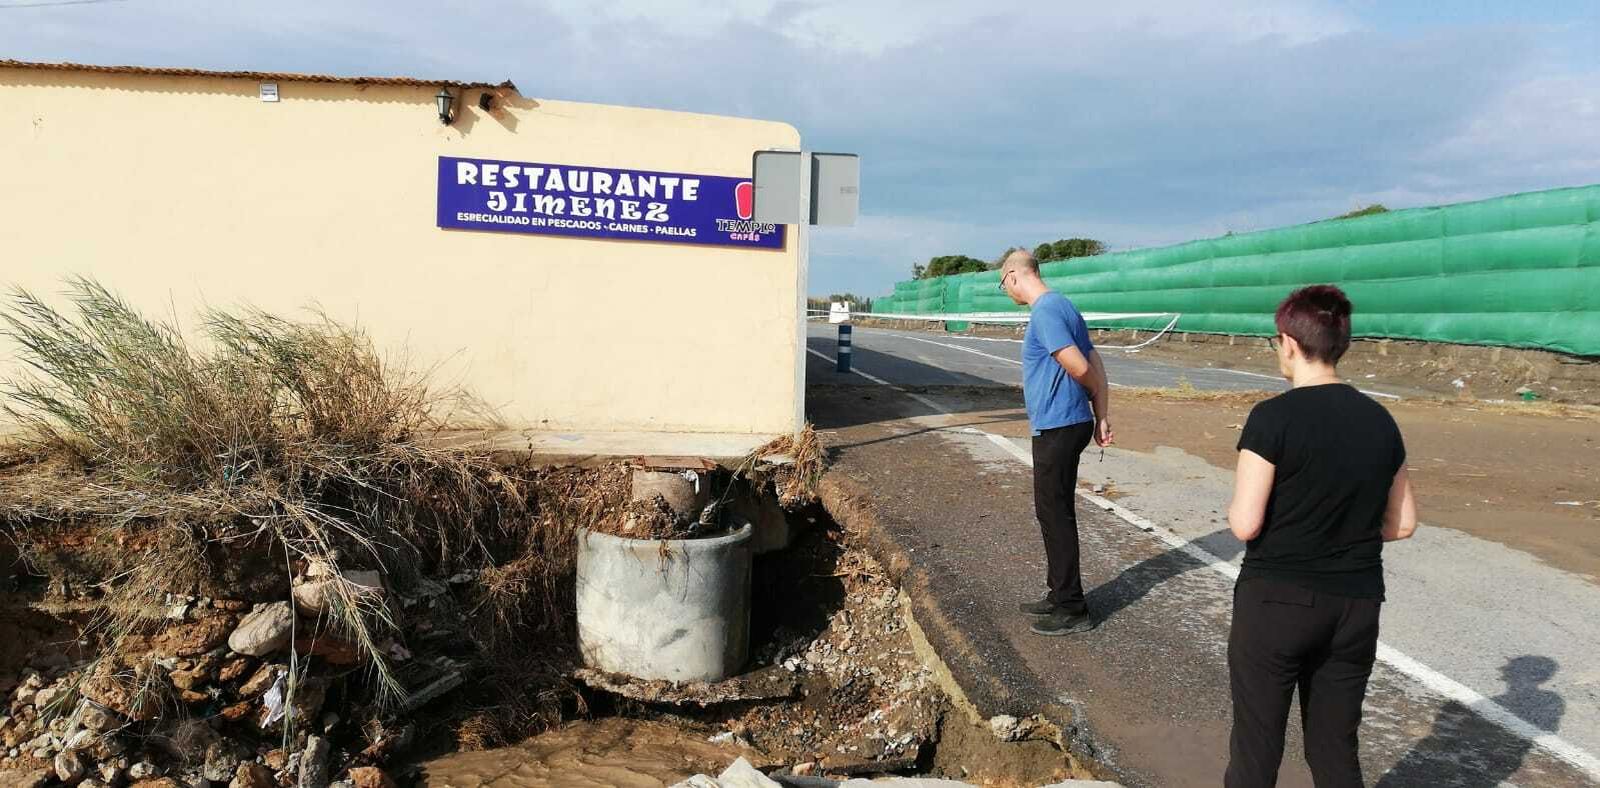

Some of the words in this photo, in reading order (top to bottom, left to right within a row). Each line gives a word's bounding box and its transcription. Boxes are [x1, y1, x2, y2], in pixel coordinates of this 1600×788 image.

[457, 161, 700, 201] RESTAURANTE
[486, 191, 670, 222] JIMENEZ
[457, 212, 530, 226] ESPECIALIDAD
[532, 217, 546, 227] EN
[548, 218, 601, 231] PESCADOS
[609, 223, 649, 234] CARNES
[655, 226, 697, 237] PAELLAS
